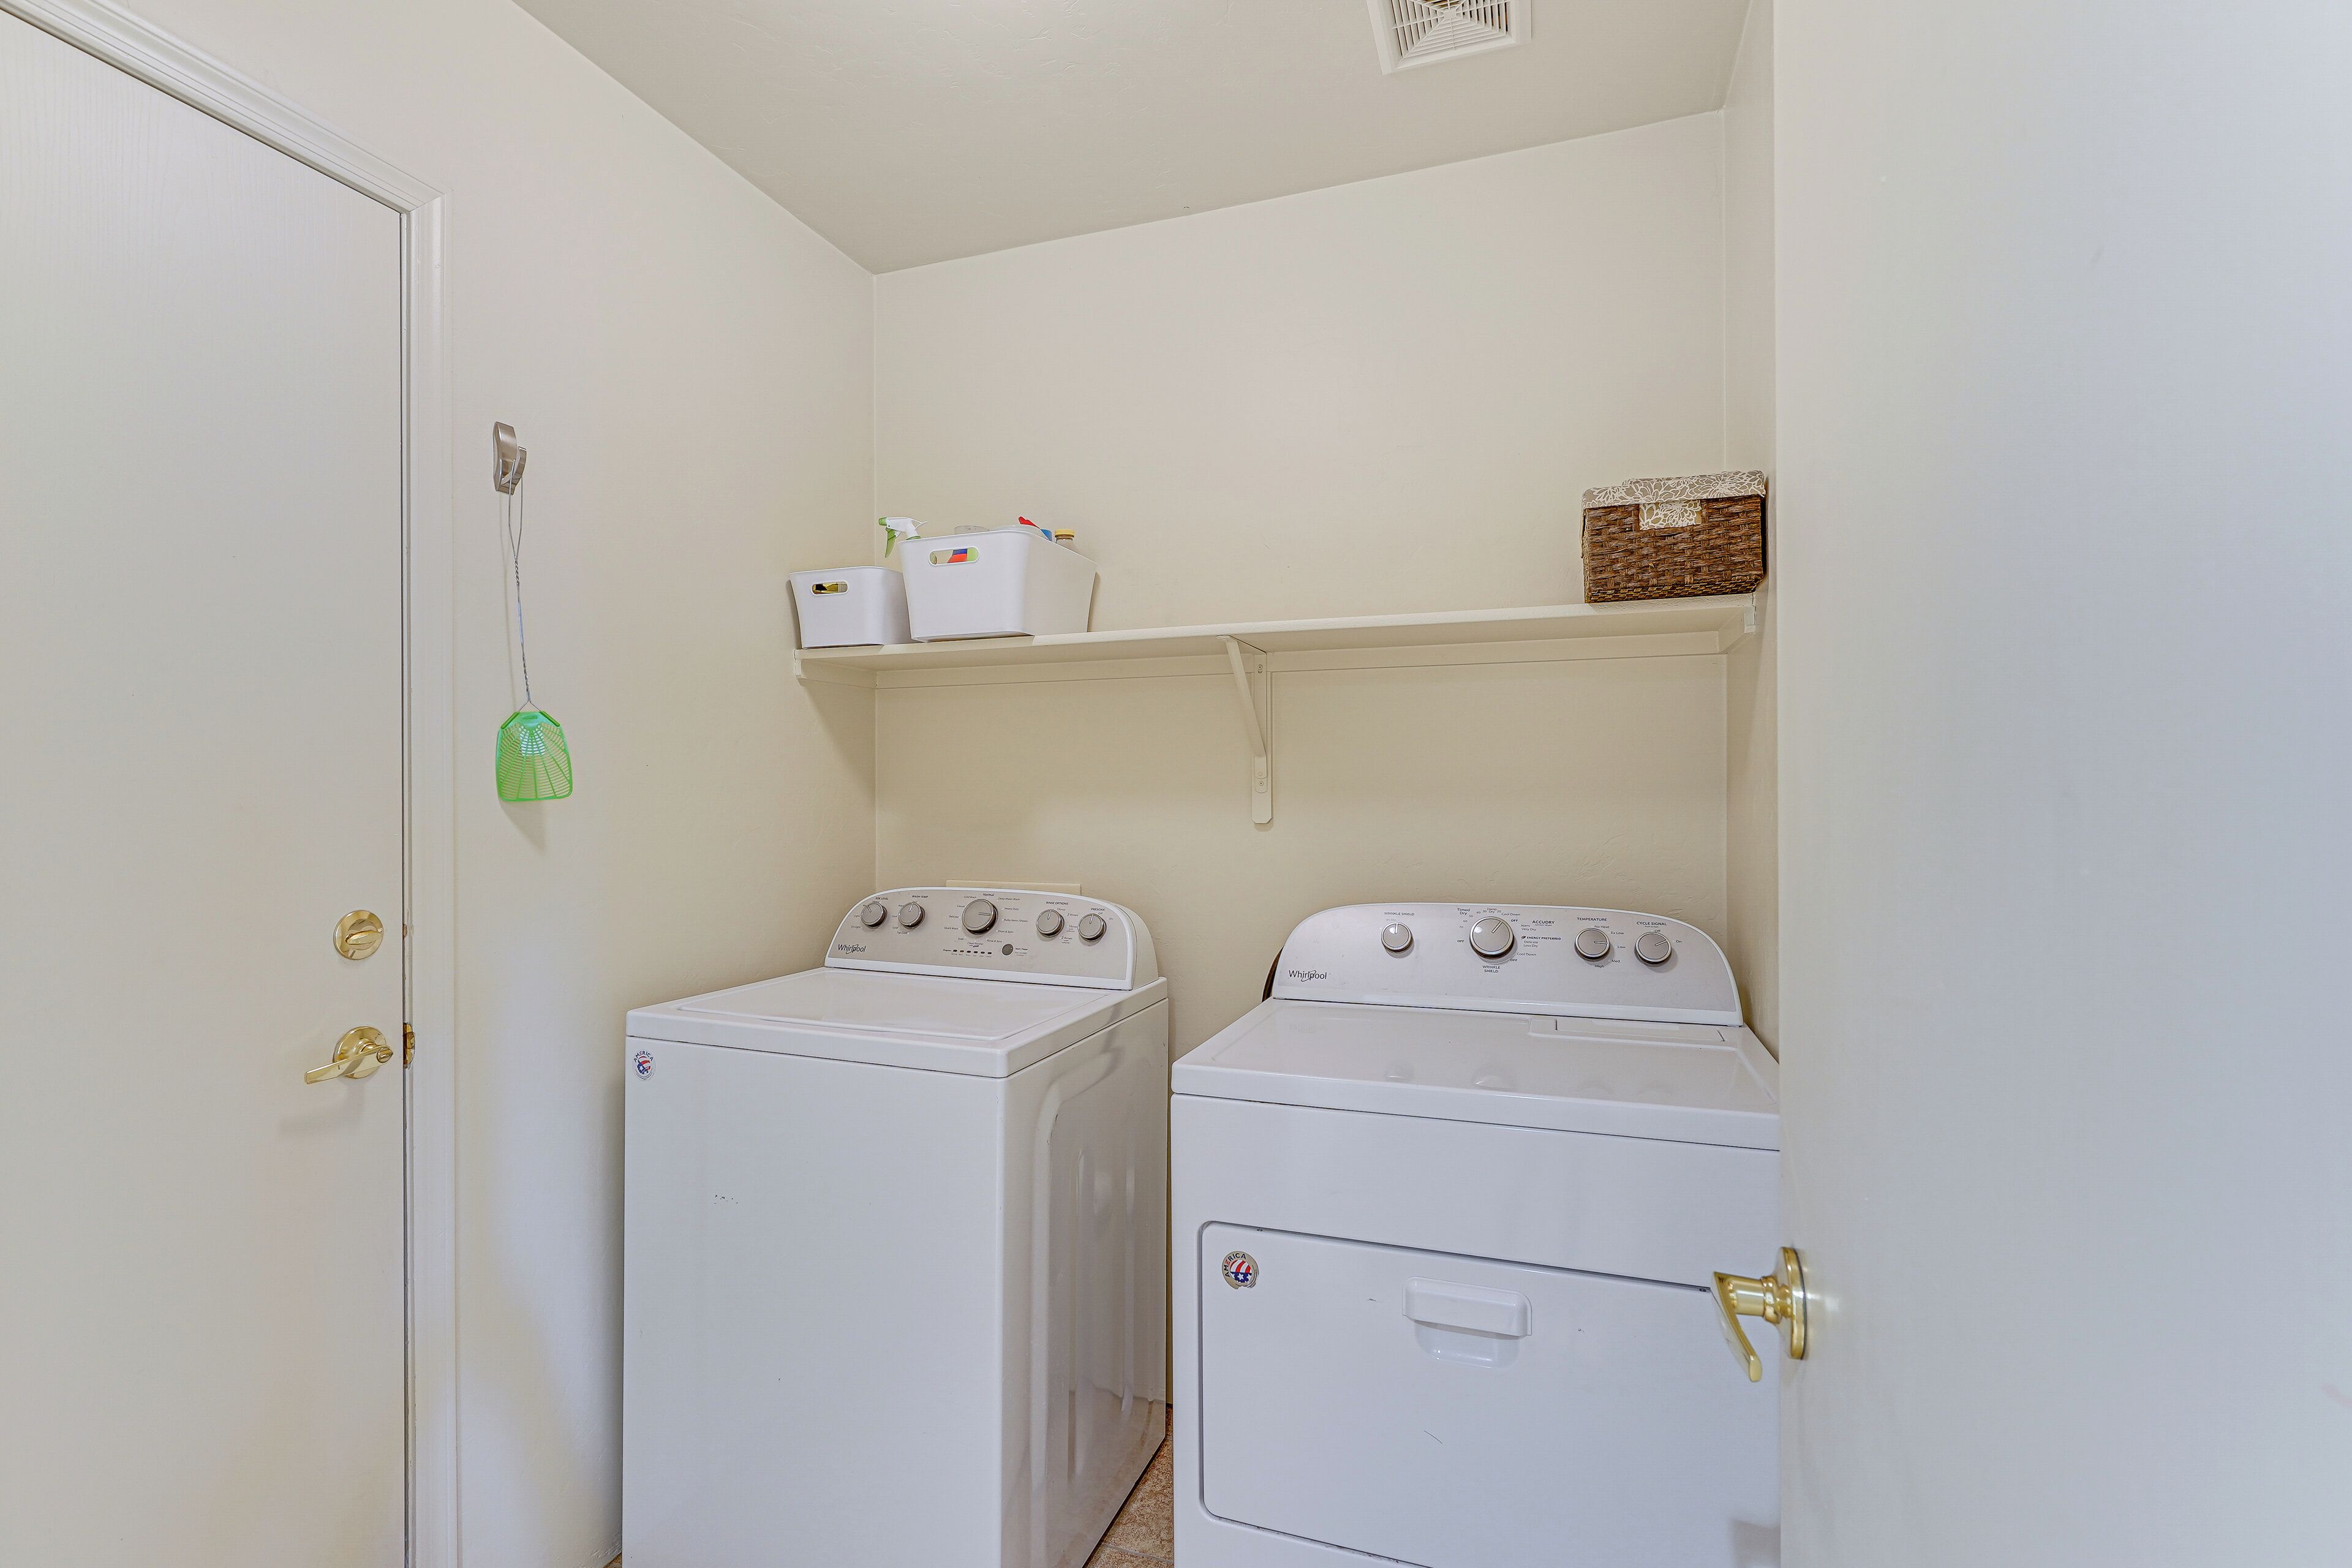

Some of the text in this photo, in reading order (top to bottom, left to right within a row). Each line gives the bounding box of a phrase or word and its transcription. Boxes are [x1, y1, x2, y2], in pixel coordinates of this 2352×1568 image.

[838, 944, 866, 954] Whirlpool
[1289, 970, 1327, 982] Whirlpool
[633, 1050, 654, 1063] AMERICA
[1224, 1253, 1246, 1278] AMERICA
